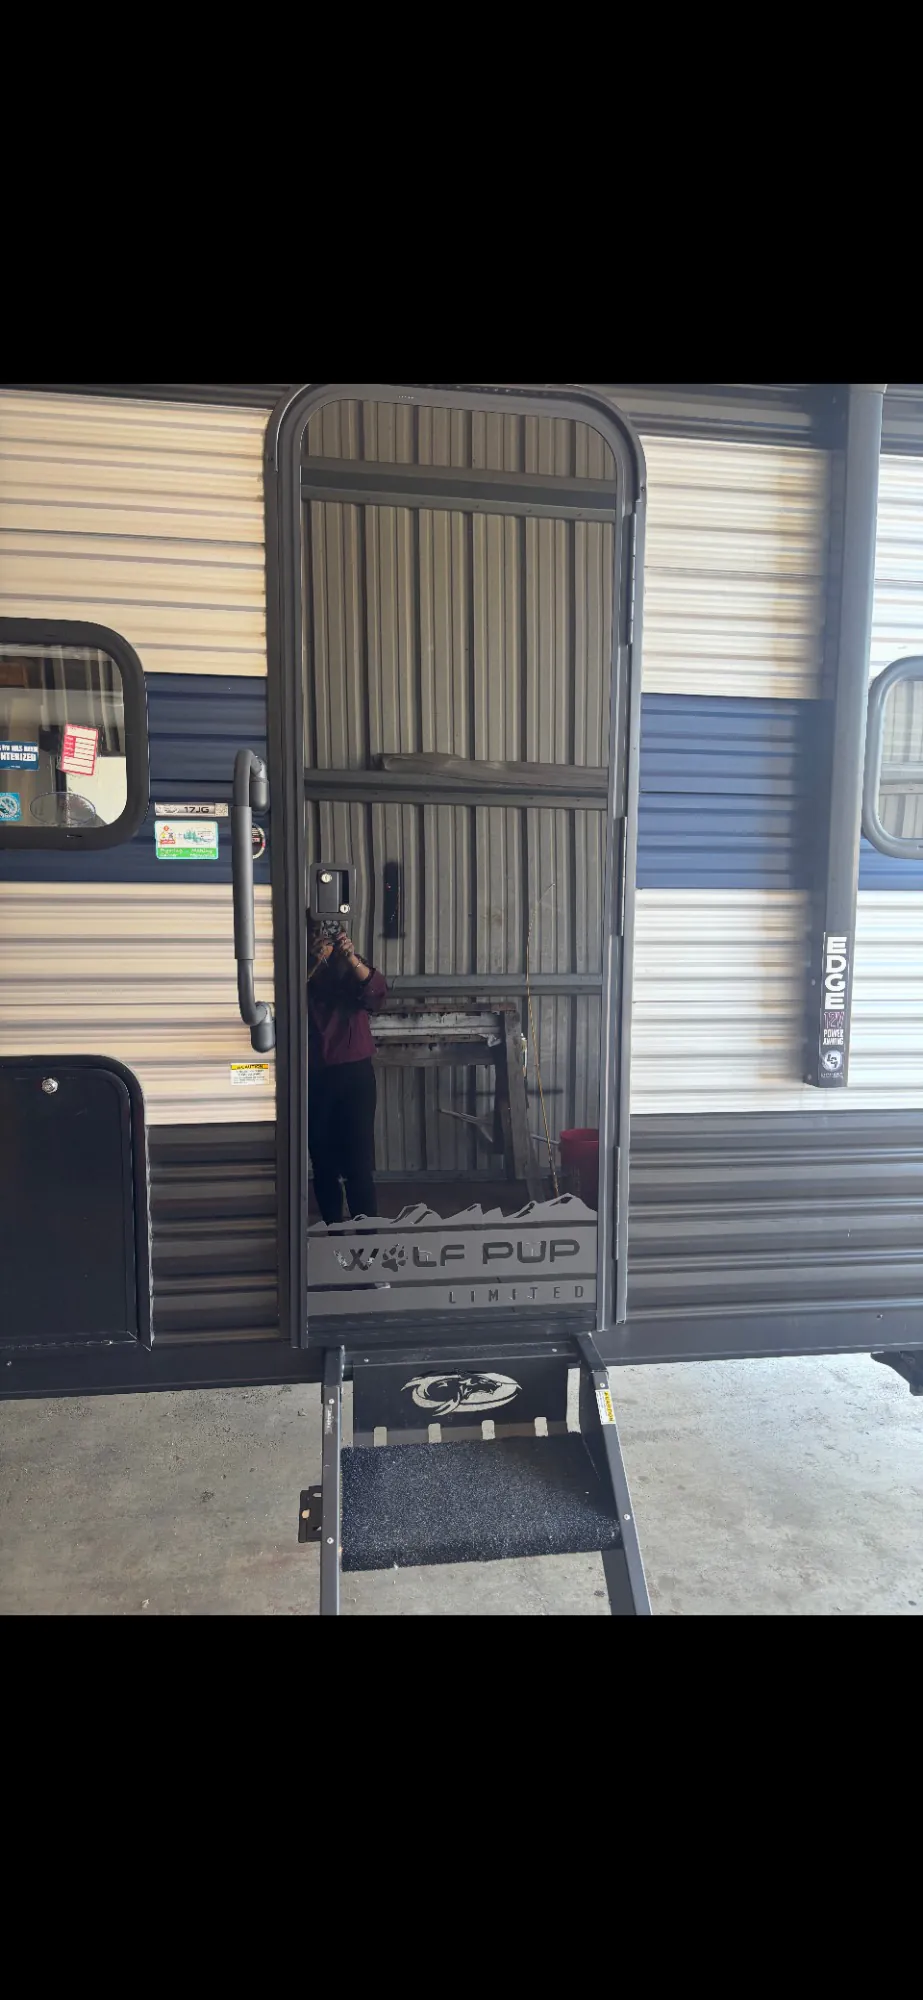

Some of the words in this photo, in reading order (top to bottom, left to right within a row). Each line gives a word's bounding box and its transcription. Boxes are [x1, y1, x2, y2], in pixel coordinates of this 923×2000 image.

[824, 936, 847, 1009] EDGE
[823, 1029, 844, 1038] POWER
[482, 1239, 580, 1265] PUP
[449, 1286, 584, 1304] LIMITED
